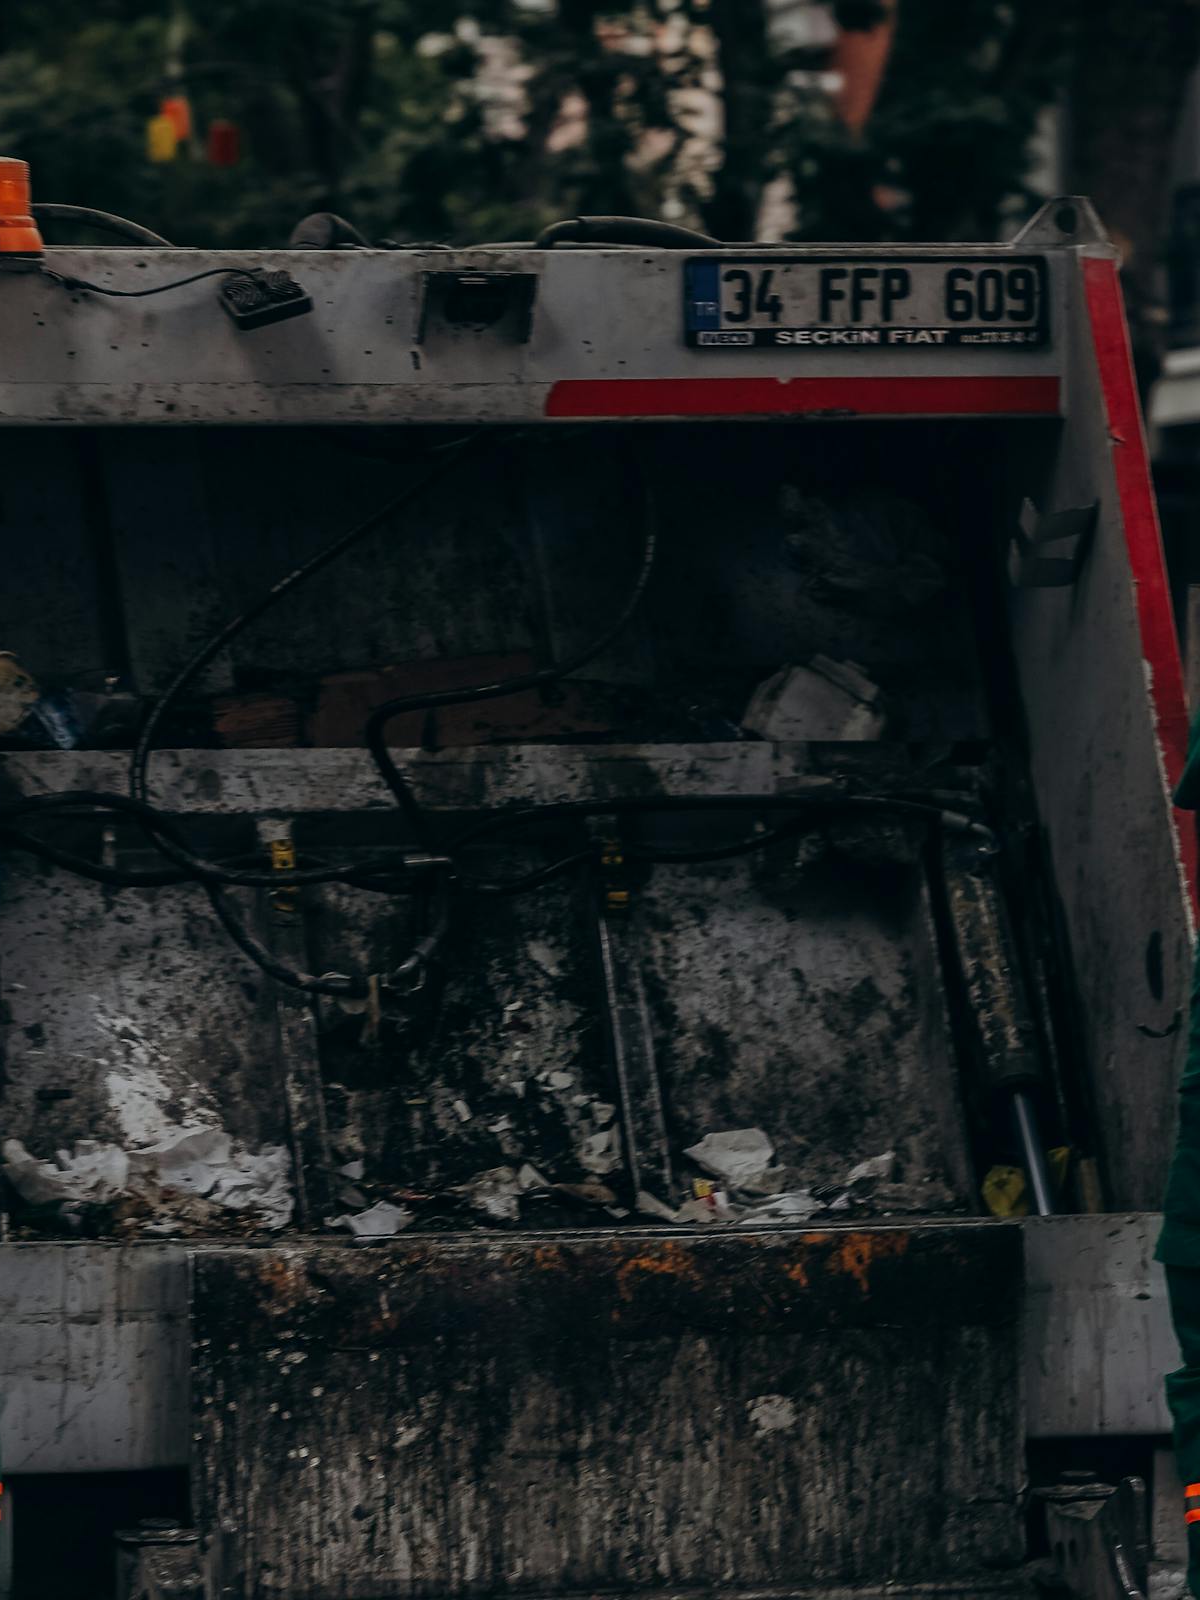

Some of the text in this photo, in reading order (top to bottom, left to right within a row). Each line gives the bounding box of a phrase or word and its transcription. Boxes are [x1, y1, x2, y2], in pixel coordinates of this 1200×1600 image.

[723, 267, 1036, 322] 34 FFP 609
